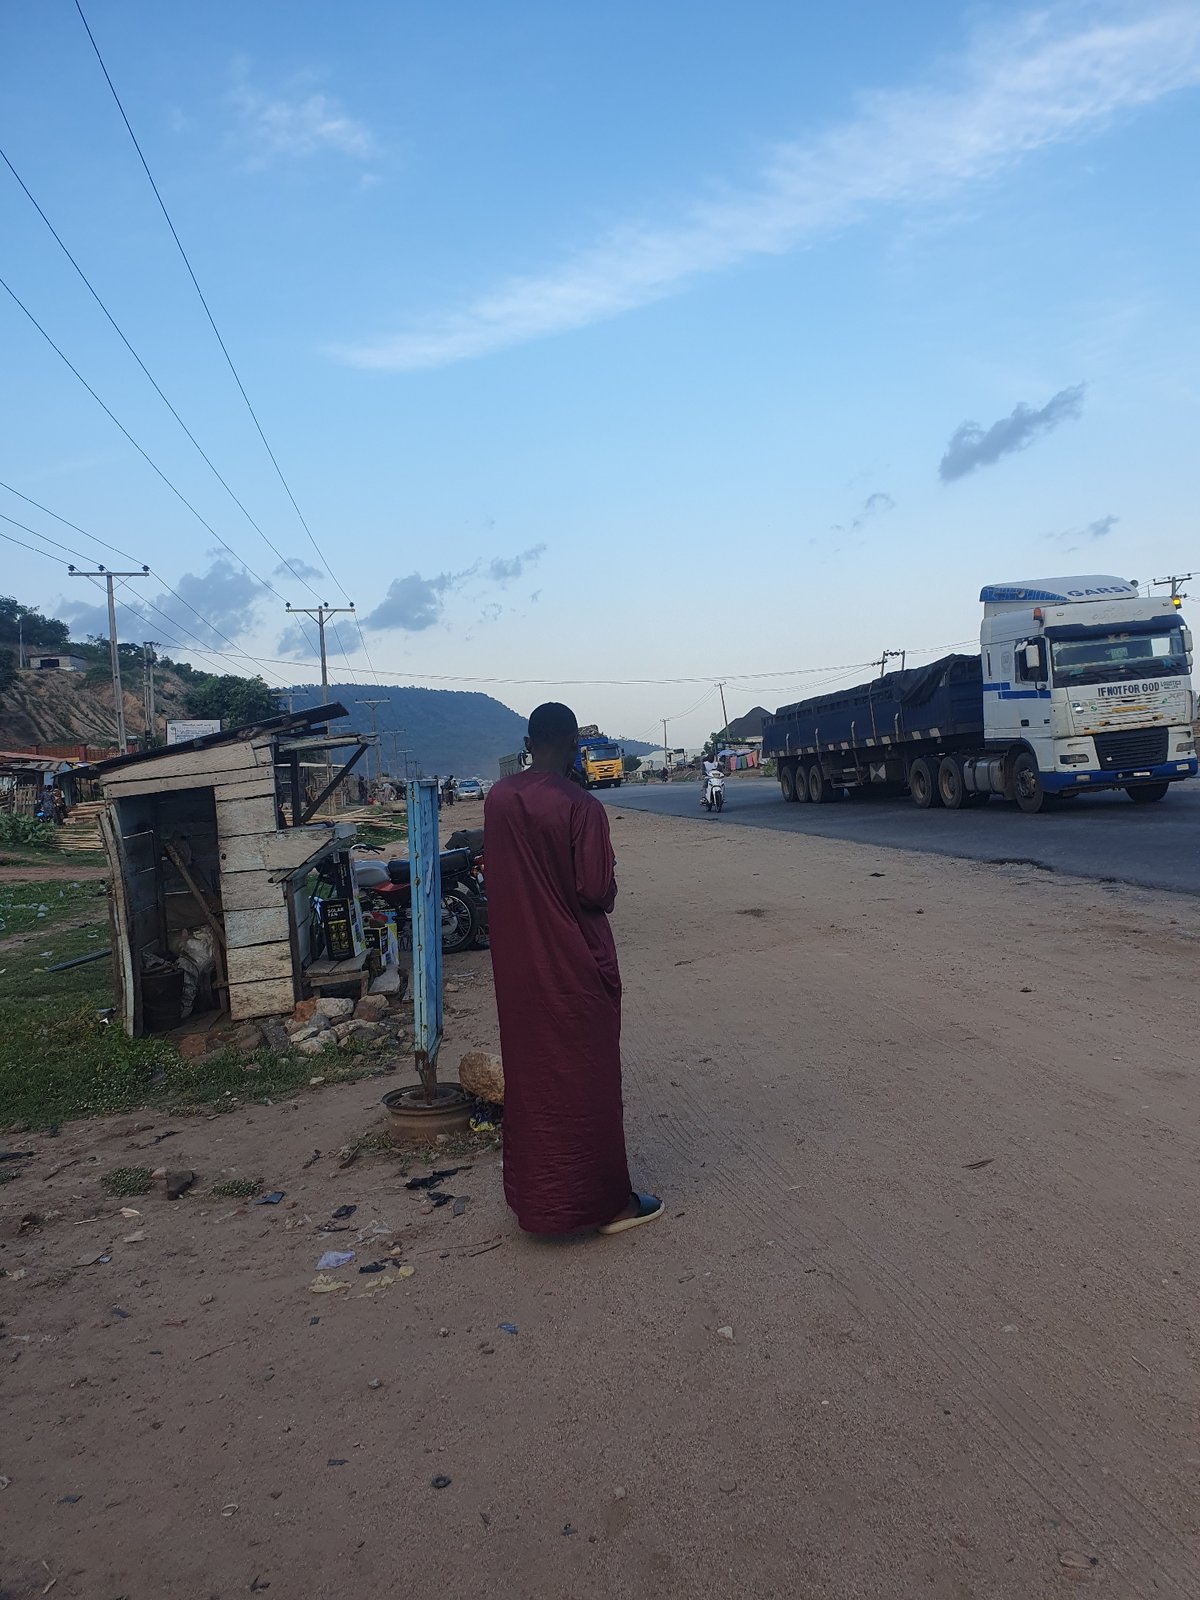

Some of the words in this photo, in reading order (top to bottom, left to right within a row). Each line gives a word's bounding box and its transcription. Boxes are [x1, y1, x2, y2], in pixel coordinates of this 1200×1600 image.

[1098, 687, 1106, 697] IF
[1107, 685, 1122, 696] NOT
[1123, 684, 1140, 694] FOR
[1142, 682, 1159, 692] GOD
